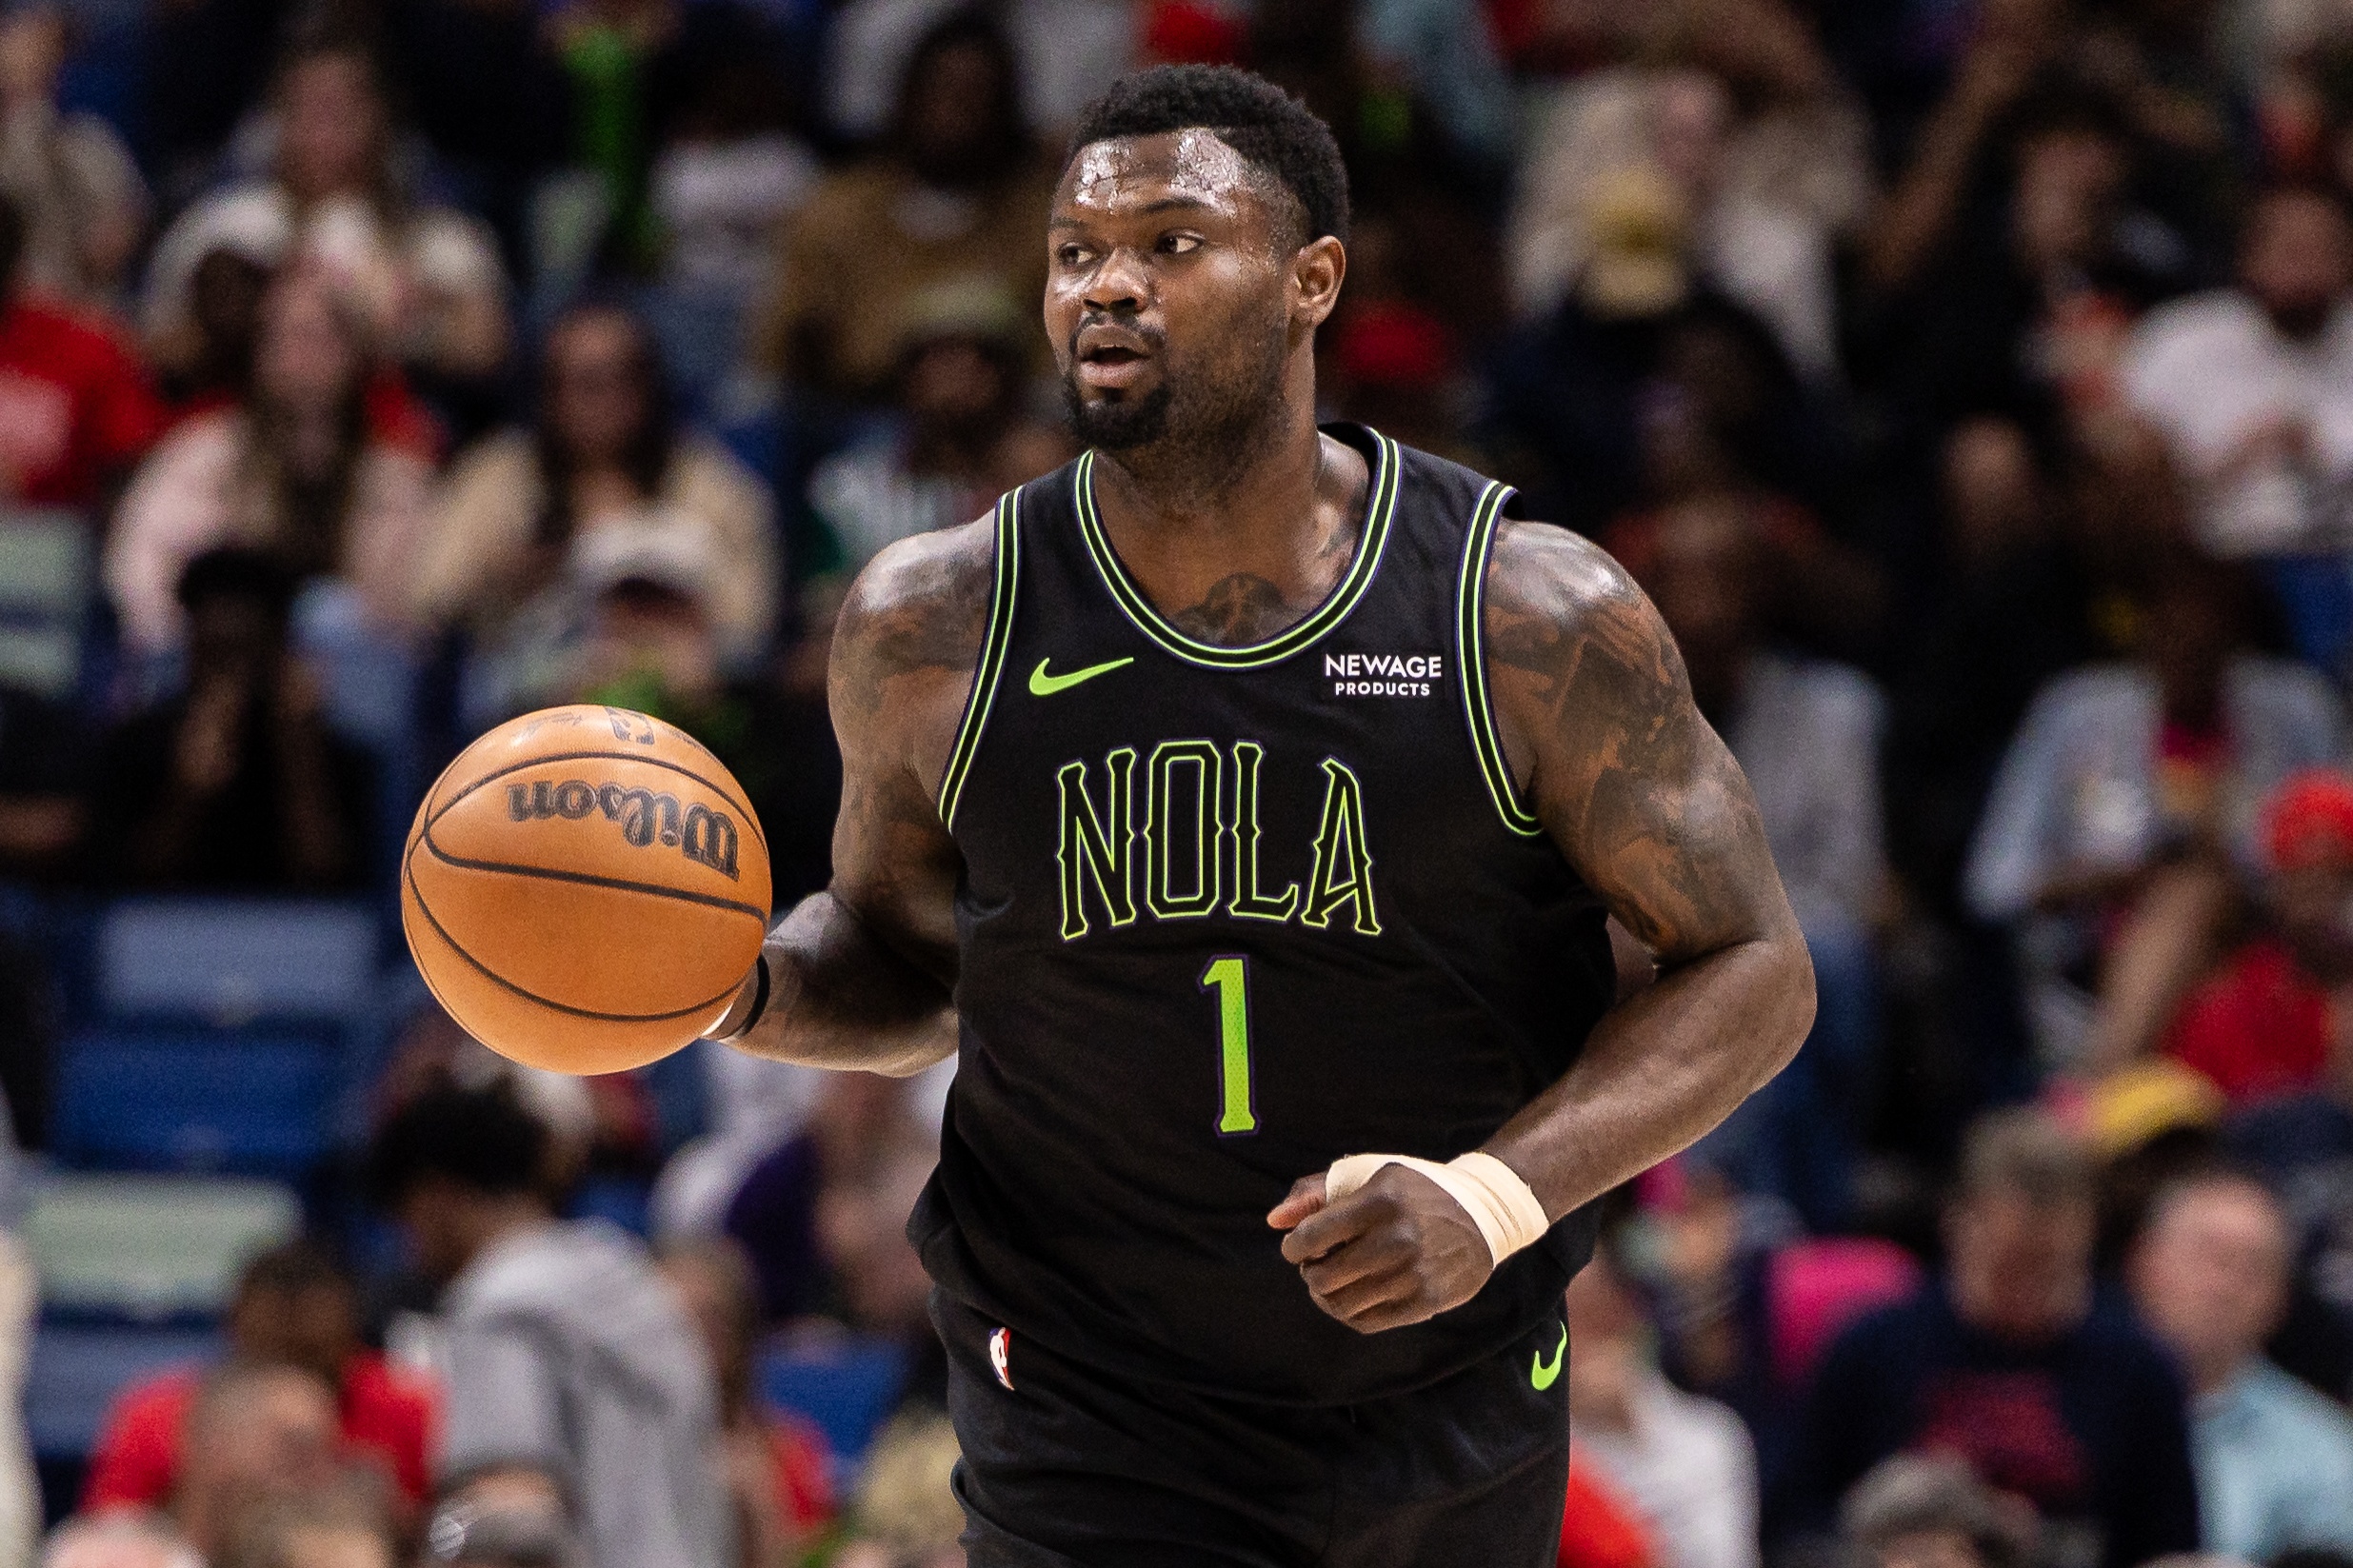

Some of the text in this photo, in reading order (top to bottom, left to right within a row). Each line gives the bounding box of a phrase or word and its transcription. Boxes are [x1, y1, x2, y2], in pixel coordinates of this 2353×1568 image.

[1325, 653, 1442, 678] NEWAGE
[1335, 682, 1430, 696] PRODUCTS
[507, 780, 740, 883] Wilson
[1056, 739, 1383, 942] NOLA
[1199, 955, 1259, 1135] 1
